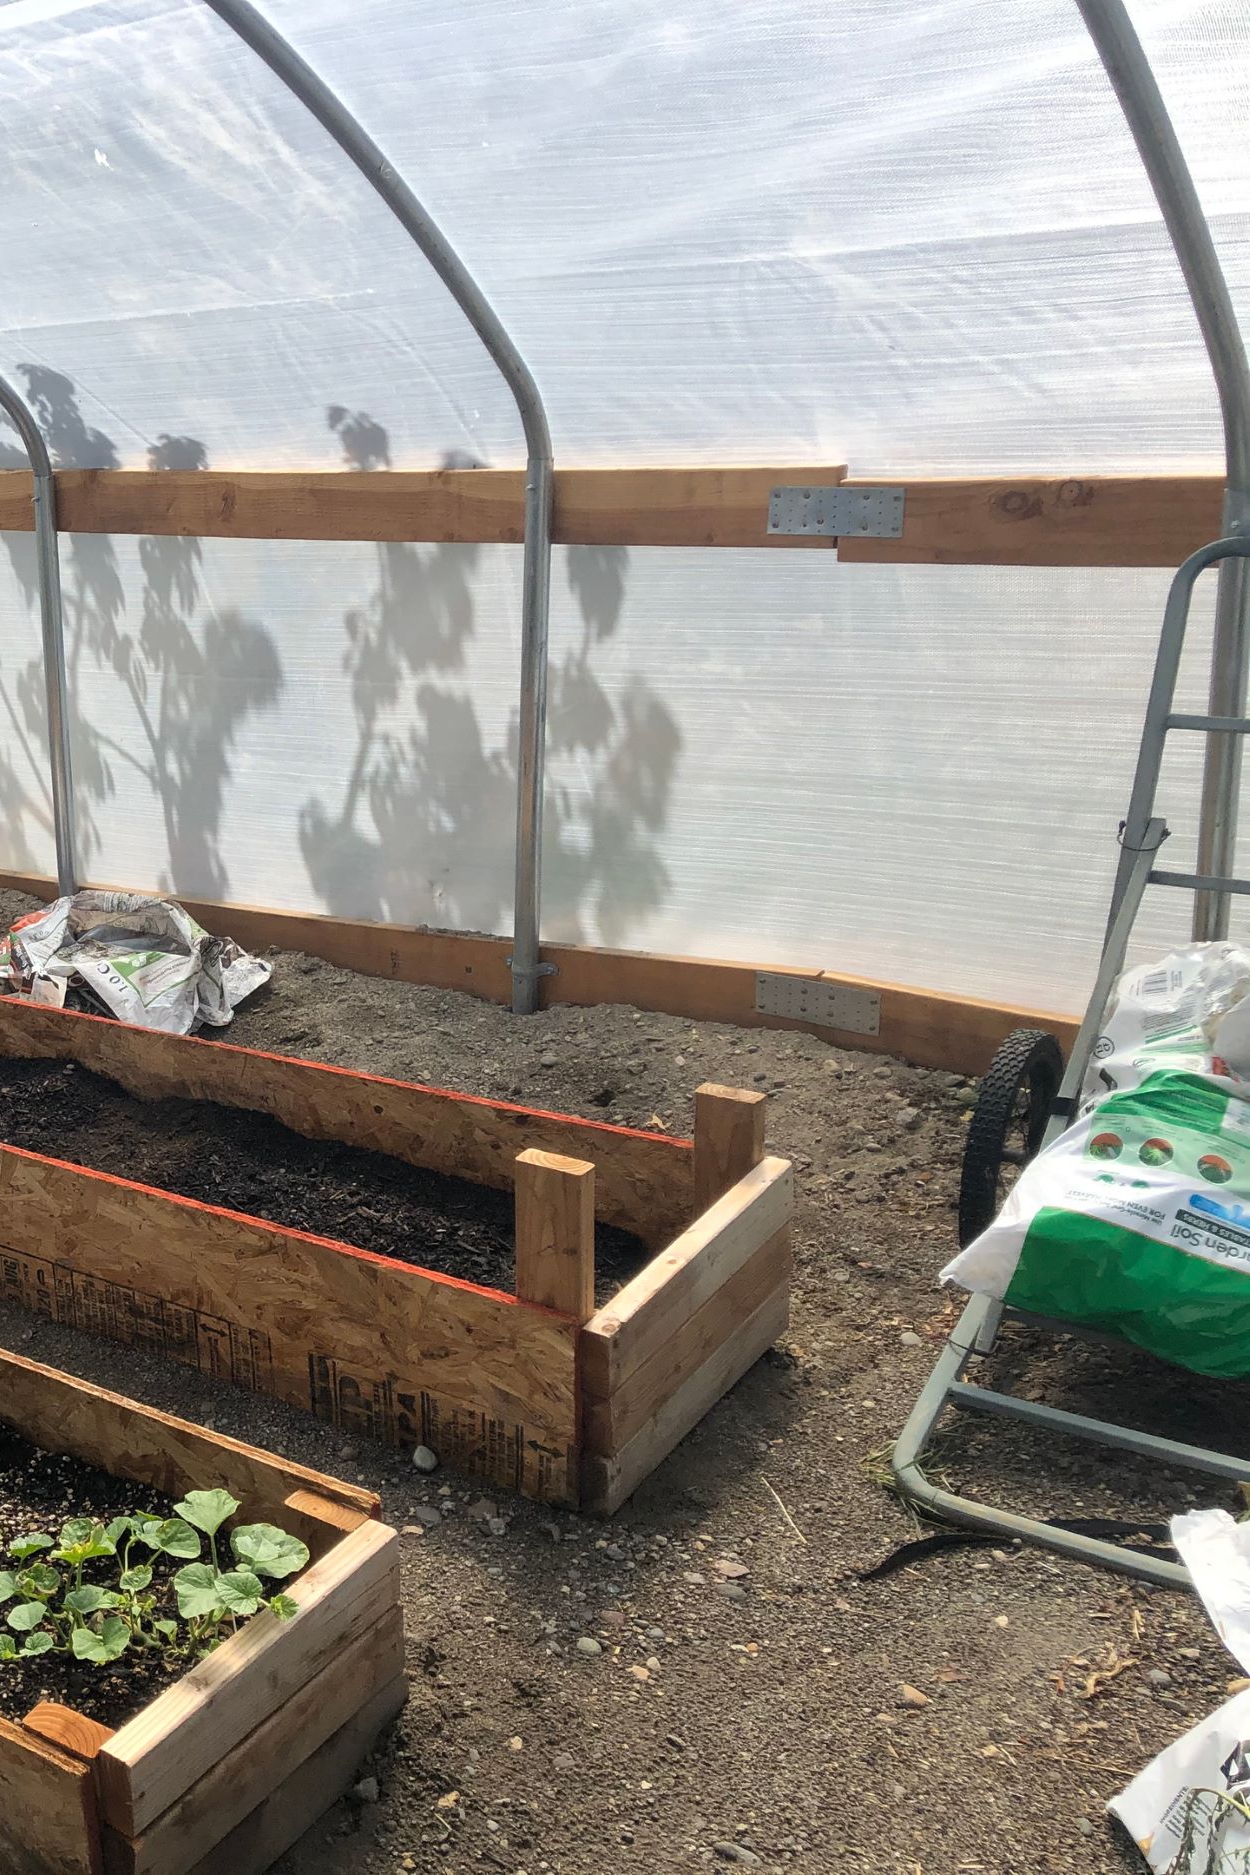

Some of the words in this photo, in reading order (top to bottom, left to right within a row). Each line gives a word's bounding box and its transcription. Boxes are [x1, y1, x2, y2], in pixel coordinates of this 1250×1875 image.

[97, 963, 110, 975] C
[109, 976, 128, 992] 1.0
[1126, 1201, 1150, 1215] EVEN
[1150, 1207, 1166, 1220] FOR
[1170, 1224, 1203, 1247] Soil
